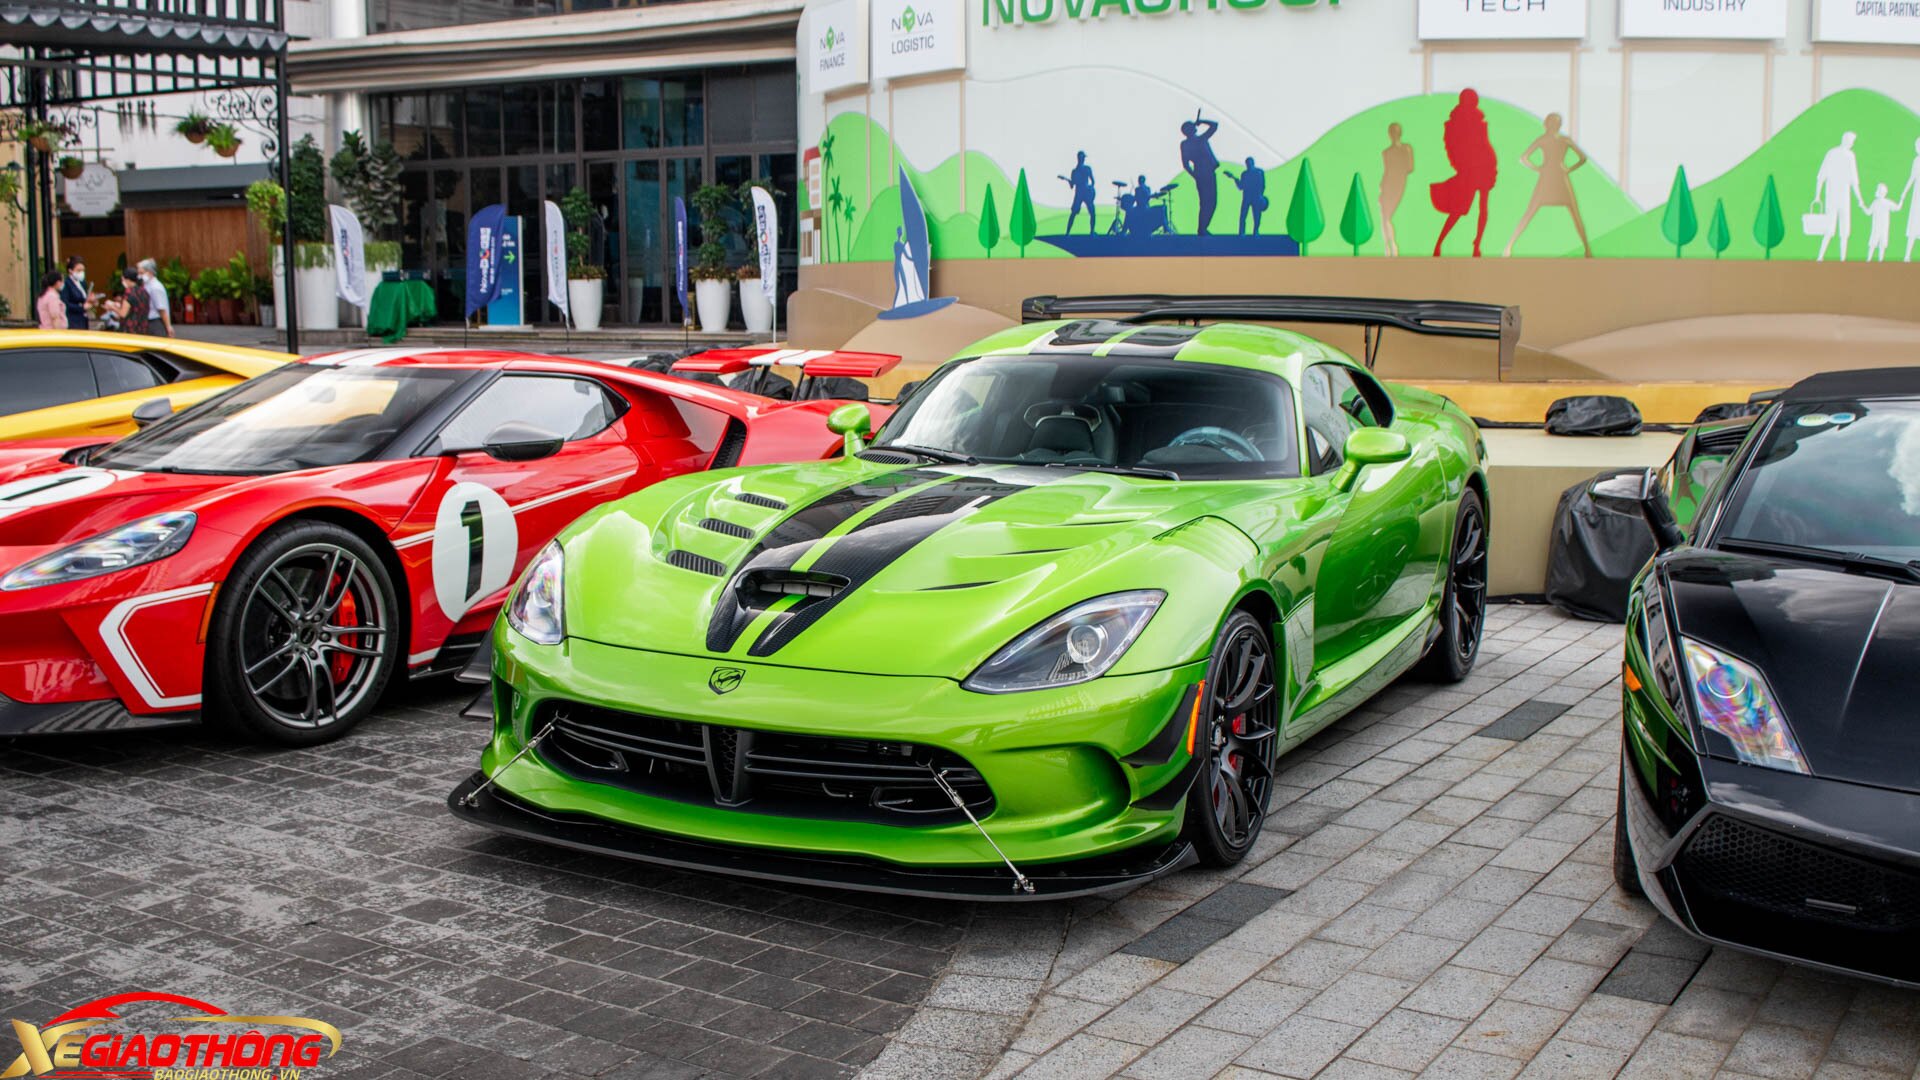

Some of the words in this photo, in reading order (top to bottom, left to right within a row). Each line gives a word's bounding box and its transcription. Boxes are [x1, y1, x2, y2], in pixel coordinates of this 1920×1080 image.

[1855, 0, 1887, 17] CAPITAL
[891, 35, 935, 55] LOGISTIC
[819, 53, 845, 72] FINANCE
[460, 500, 484, 603] 1
